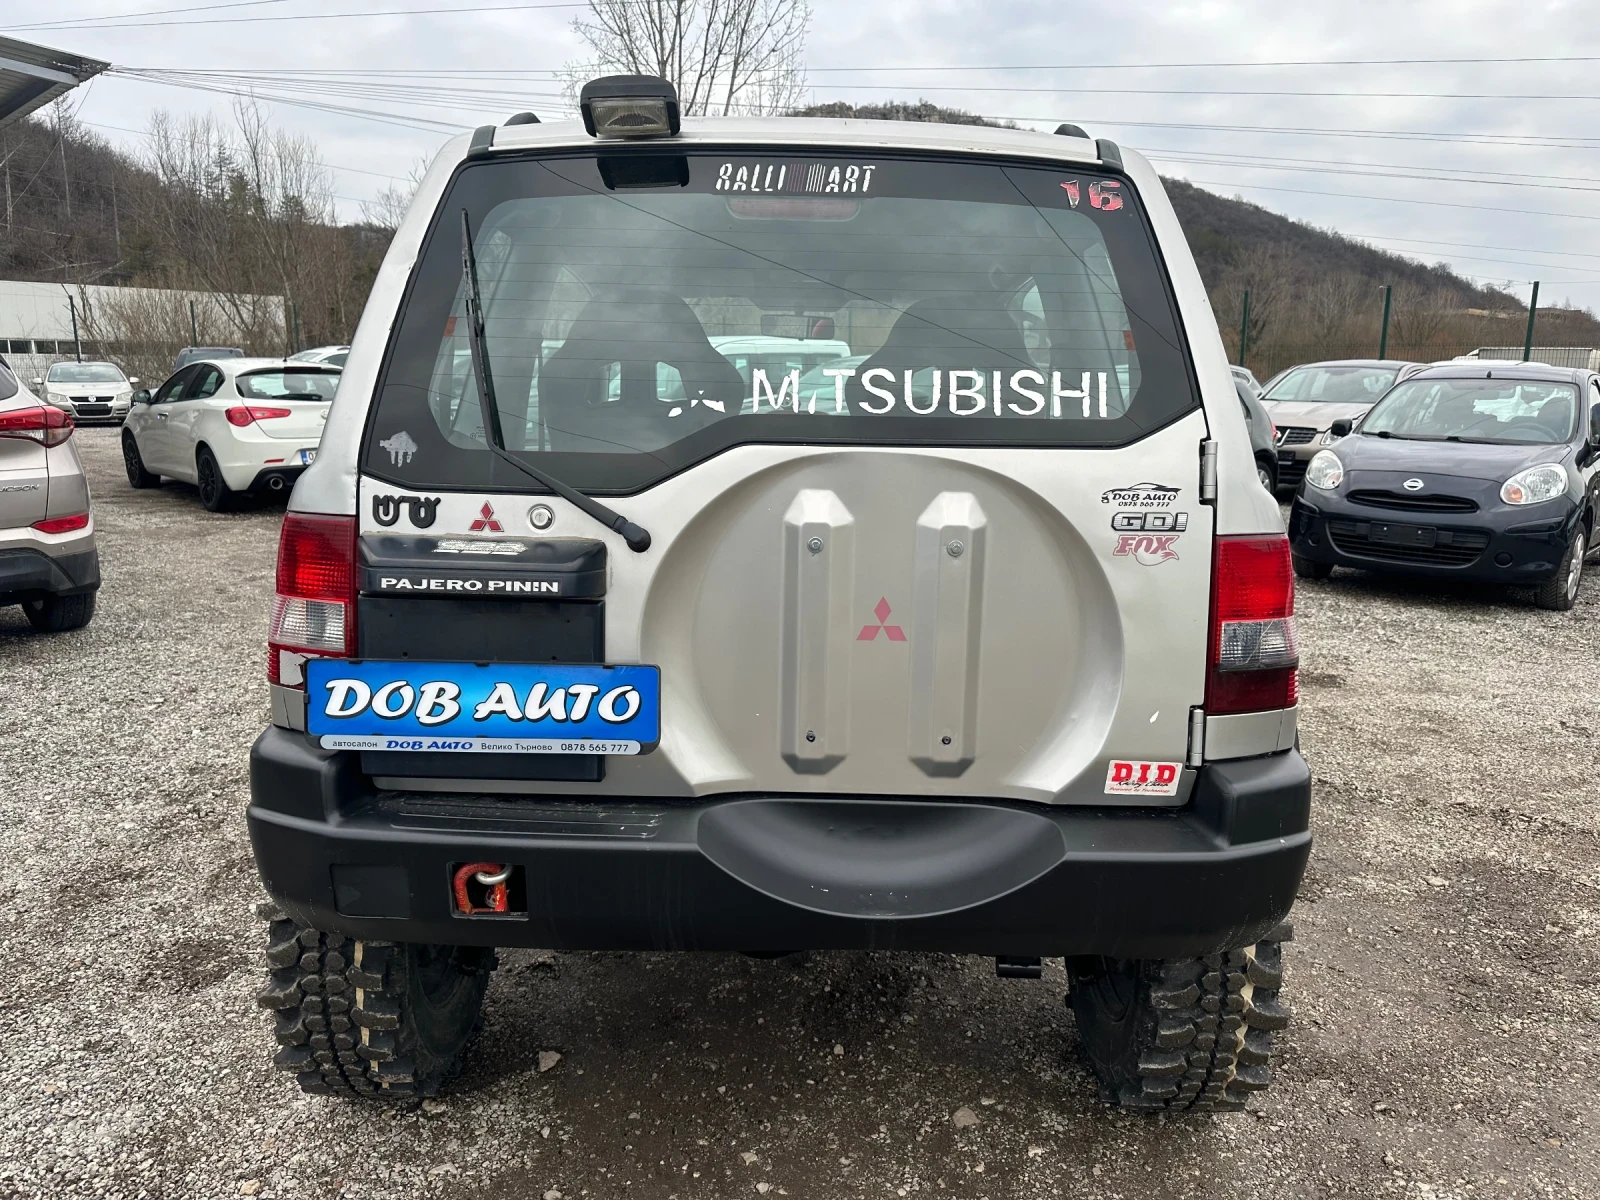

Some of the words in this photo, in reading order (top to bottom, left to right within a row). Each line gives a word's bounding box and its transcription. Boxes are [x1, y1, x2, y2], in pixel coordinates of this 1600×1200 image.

[715, 163, 786, 192] RALLI
[824, 165, 876, 193] ART
[1060, 180, 1124, 211] 16
[1112, 493, 1140, 502] DOB
[1143, 493, 1177, 502] AUTO
[1111, 511, 1189, 532] GDI
[1113, 535, 1180, 557] FOX
[380, 577, 483, 591] PAJERO
[324, 678, 461, 725] DOB
[473, 681, 641, 724] AUTO
[332, 740, 378, 748] автосалон
[386, 740, 424, 750] DOB
[427, 740, 473, 750] AUTO
[480, 742, 513, 751] Велико
[515, 743, 553, 752] Търново
[560, 743, 586, 752] 0878
[588, 743, 607, 752] 565
[611, 744, 629, 752] 777
